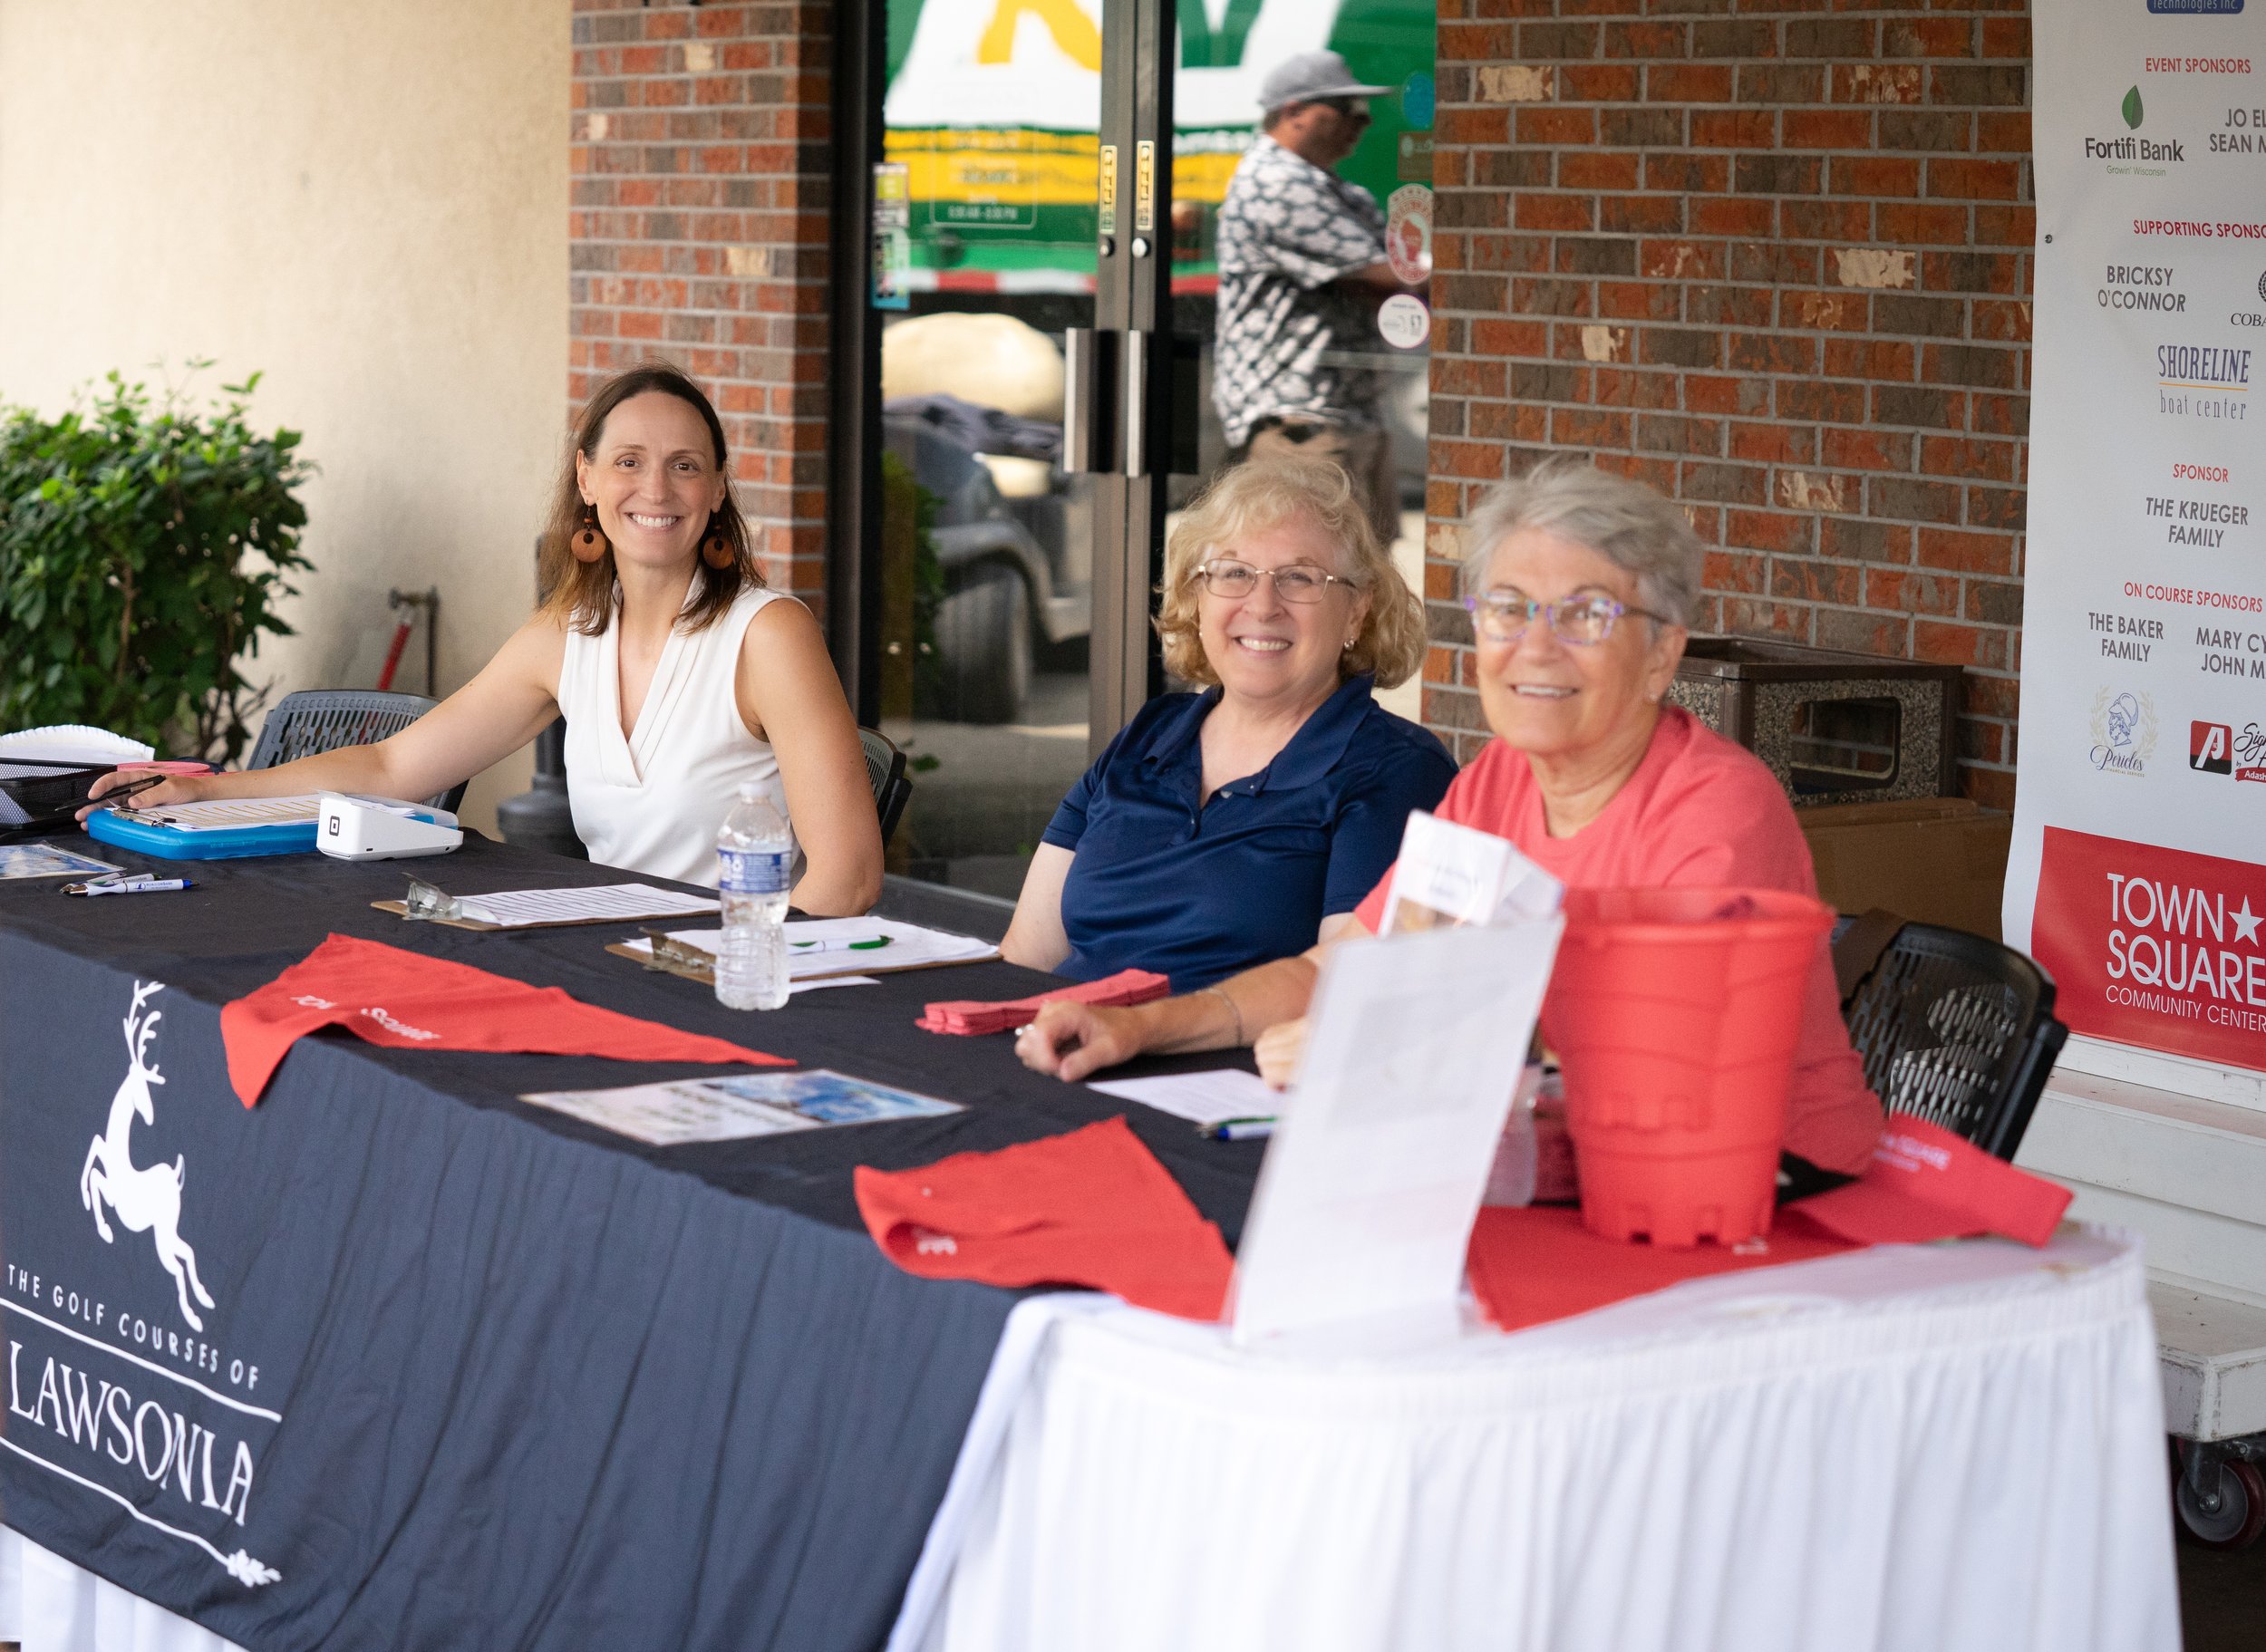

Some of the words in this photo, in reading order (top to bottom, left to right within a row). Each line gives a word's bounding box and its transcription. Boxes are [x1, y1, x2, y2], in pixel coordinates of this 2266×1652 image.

[2154, 0, 2218, 13] Technologies
[2145, 57, 2182, 72] EVENT
[2185, 57, 2251, 74] SPONSORS
[2224, 108, 2247, 128] JO
[2085, 137, 2136, 159] Fortifi
[2140, 139, 2184, 162] Bank
[2209, 132, 2252, 153] SEAN
[2133, 167, 2166, 177] Wisconsin
[2133, 219, 2213, 237] SUPPORTING
[2106, 265, 2174, 286] BRICKSY
[2097, 288, 2186, 313] O'CONNOR
[2157, 344, 2251, 383] SHORELINE
[2160, 390, 2189, 415] boat
[2196, 396, 2247, 420] center
[2173, 463, 2229, 483] SPONSOR
[2145, 497, 2174, 517] THE
[2178, 500, 2249, 526] KRUEGER
[2167, 525, 2224, 548] FAMILY
[2124, 581, 2143, 598] ON
[2145, 584, 2193, 604] COURSE
[2196, 591, 2263, 613] SPONSORS
[2088, 612, 2114, 633] THE
[2117, 616, 2164, 640] BAKER
[2195, 626, 2242, 651] MARY
[2101, 638, 2151, 662] FAMILY
[2201, 652, 2245, 677] JOHN
[2090, 744, 2145, 771] Pericles
[2106, 872, 2223, 942] TOWN
[2106, 929, 2266, 1007] SQUARE
[2106, 985, 2202, 1019] COMMUNITY
[2207, 1005, 2266, 1033] CENTER
[8, 1263, 41, 1299] THE
[53, 1285, 105, 1326] GOLF
[119, 1312, 218, 1374] COURSES
[229, 1358, 259, 1390] OF
[10, 1340, 254, 1527] LAWSONIA
